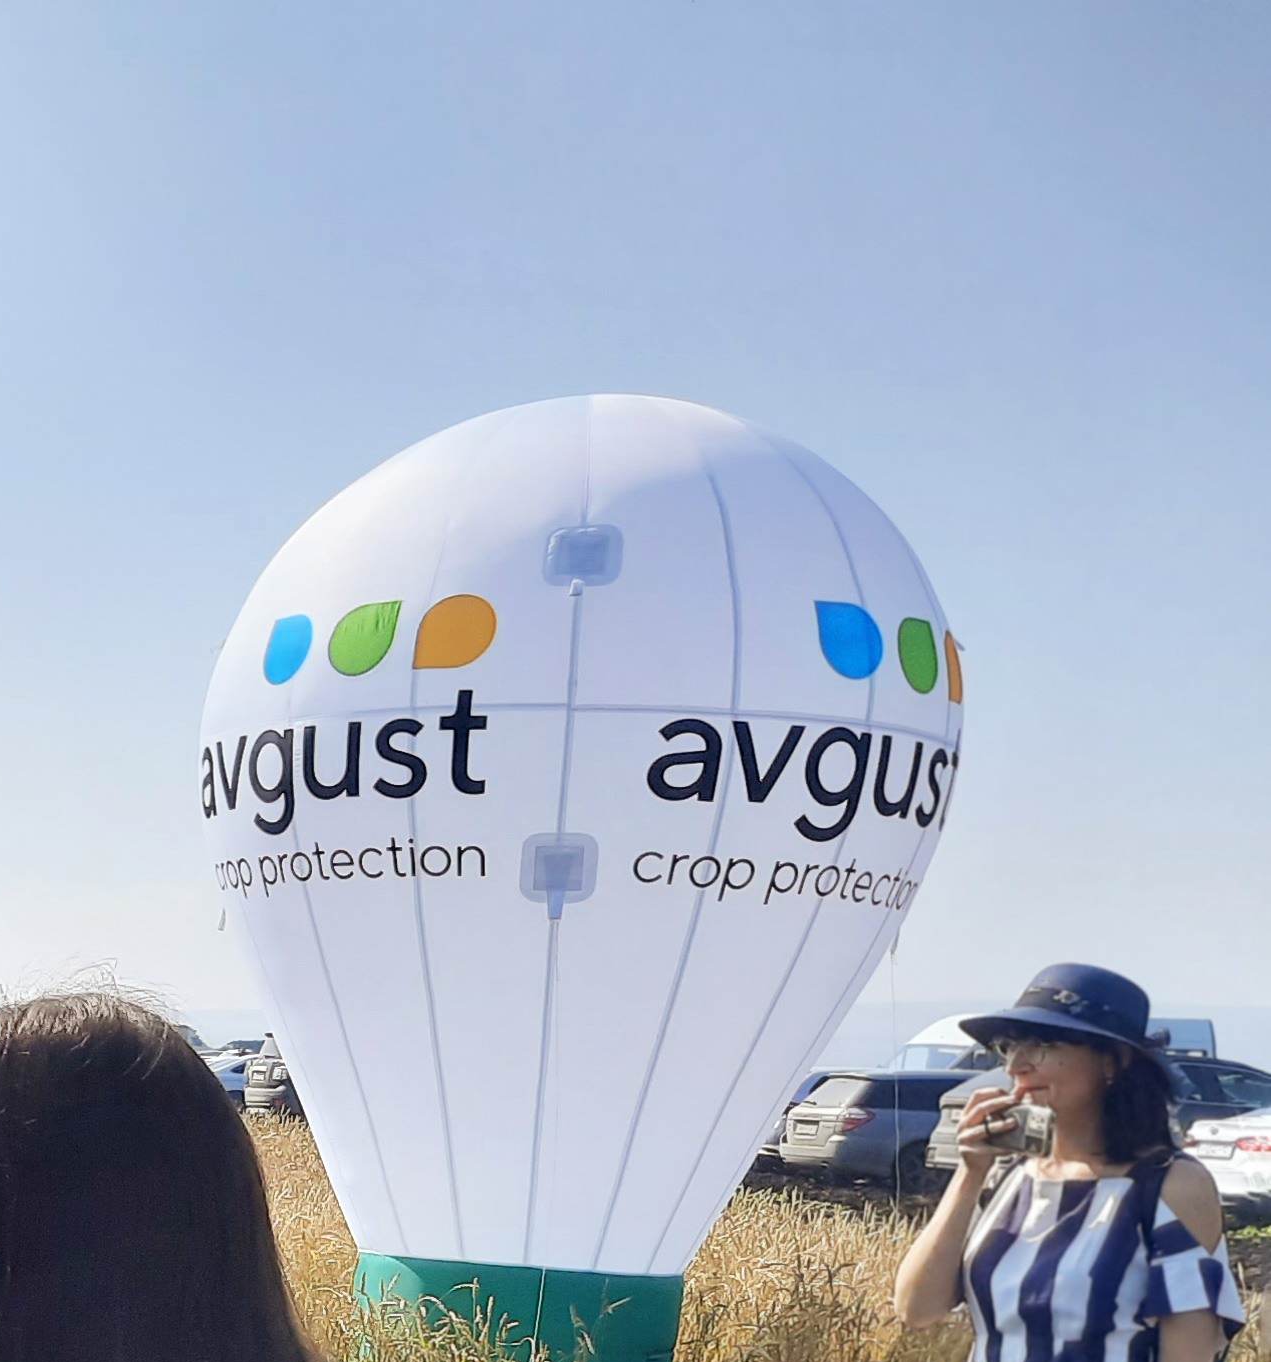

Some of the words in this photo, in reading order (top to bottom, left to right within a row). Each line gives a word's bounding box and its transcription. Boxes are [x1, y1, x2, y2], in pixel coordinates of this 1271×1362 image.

[201, 689, 488, 836] avgust
[215, 858, 253, 899] crop
[258, 836, 487, 898] protection
[631, 848, 757, 903] crop
